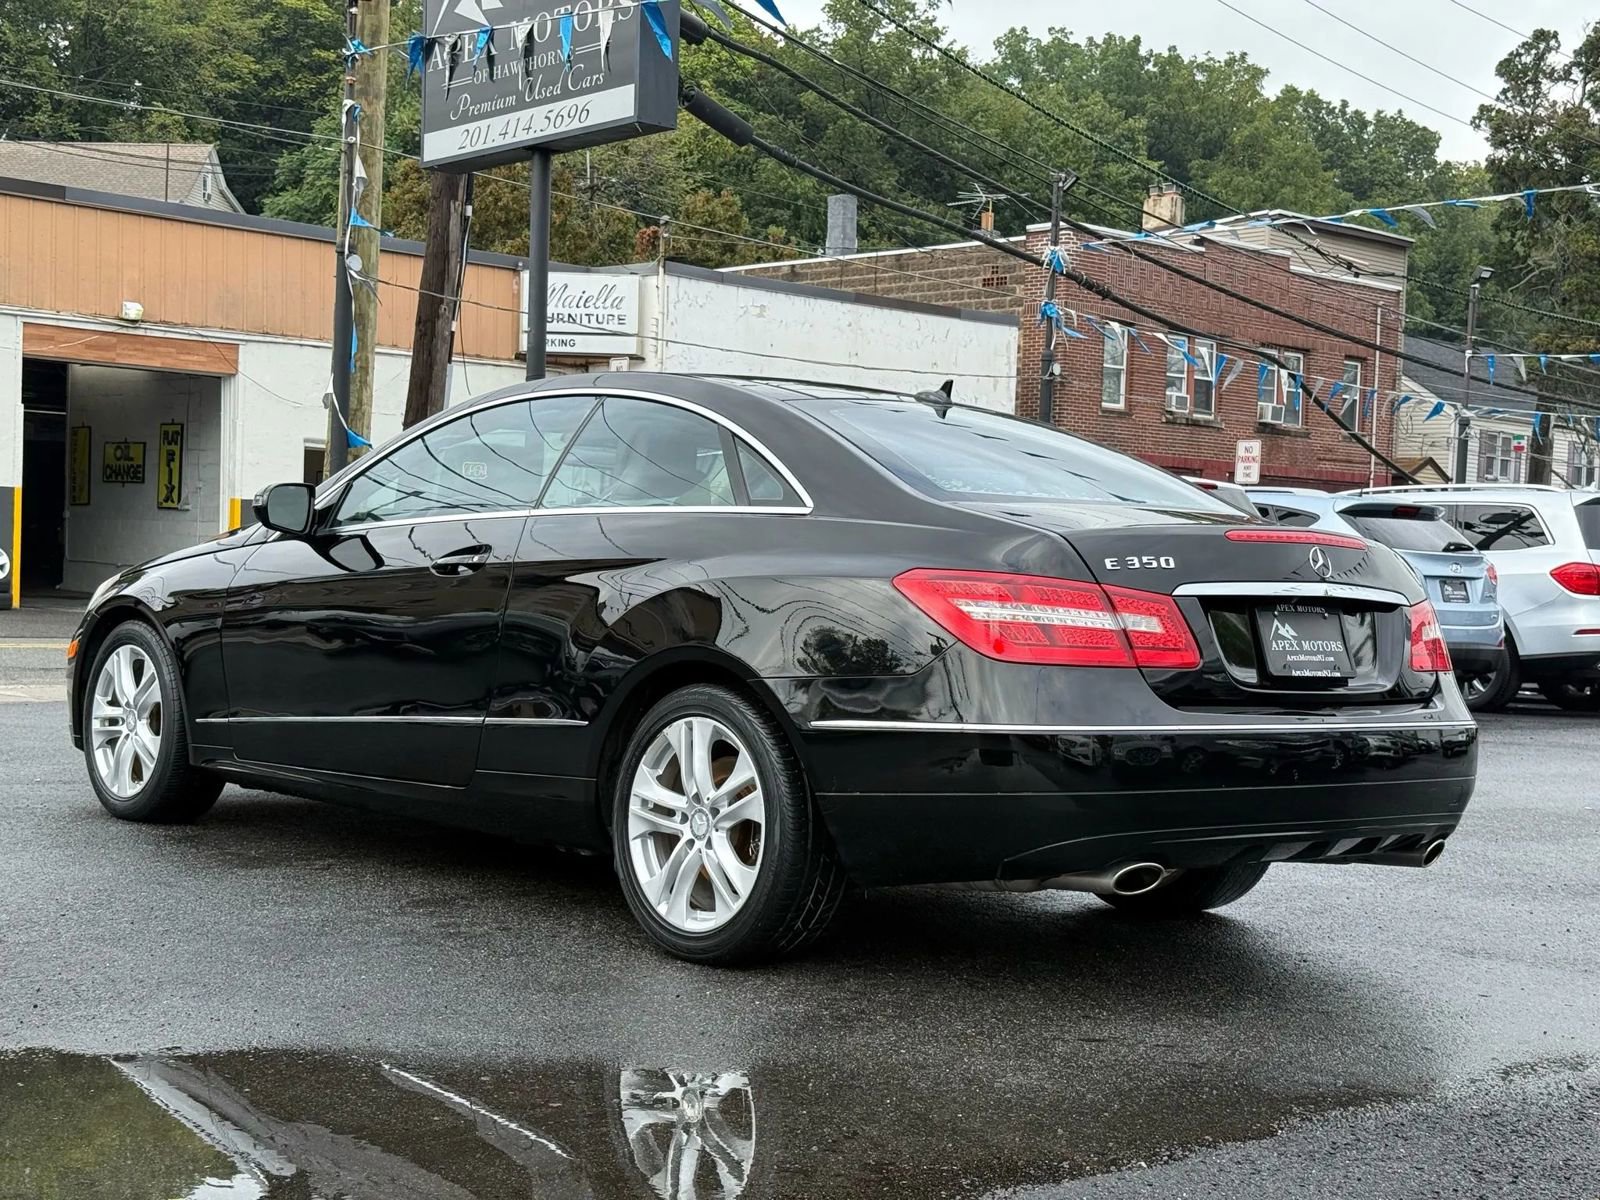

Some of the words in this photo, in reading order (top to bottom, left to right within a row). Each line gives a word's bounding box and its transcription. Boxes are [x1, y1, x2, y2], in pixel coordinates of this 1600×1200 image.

[474, 69, 489, 84] OF
[450, 93, 516, 121] Premium
[522, 68, 566, 103] Used
[568, 64, 605, 92] Cars
[457, 100, 593, 150] 201.414.5696
[546, 313, 627, 325] URNITURE
[545, 339, 576, 347] RKING
[114, 445, 135, 461] OIL
[1244, 445, 1254, 454] NO
[105, 464, 143, 481] CHANGE
[1104, 558, 1121, 570] E
[1125, 556, 1175, 569] 350
[1276, 604, 1295, 612] APEX
[1297, 605, 1326, 614] MOTORS
[1271, 640, 1300, 651] APEX
[1301, 640, 1344, 652] MOTORS
